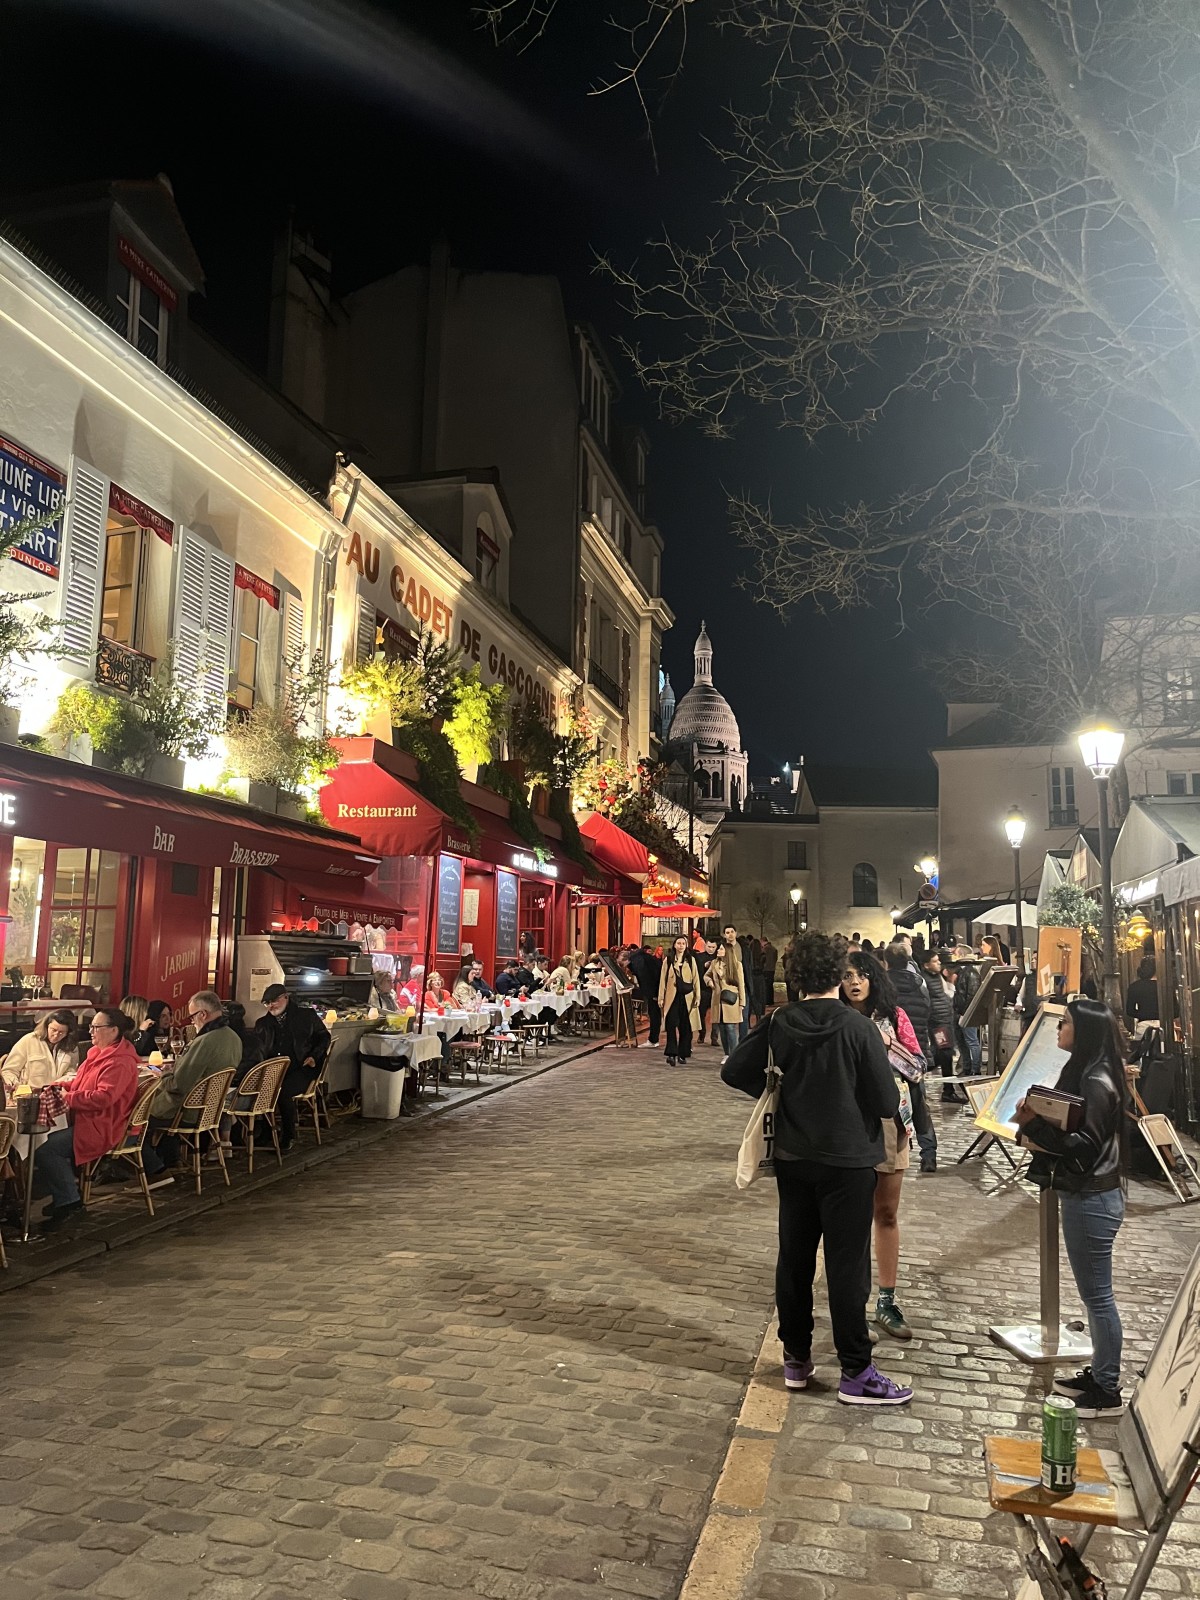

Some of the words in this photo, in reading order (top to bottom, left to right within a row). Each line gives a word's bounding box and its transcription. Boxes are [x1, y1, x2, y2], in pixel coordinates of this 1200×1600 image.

[140, 506, 173, 534] CATHERINE
[10, 548, 52, 572] DUNLOP
[346, 531, 381, 585] AU
[390, 565, 453, 641] CADET
[460, 619, 482, 662] DE
[488, 643, 557, 721] GASCOGNE
[0, 792, 16, 825] E
[337, 803, 418, 818] Restaurant
[152, 825, 176, 853] BAR
[447, 834, 471, 854] Brasserie
[313, 905, 331, 918] FRUITS
[331, 910, 338, 919] DE
[339, 909, 350, 920] MER
[353, 910, 368, 922] VENTE
[373, 913, 396, 926] EMPORTER
[160, 948, 197, 982] JARDIN
[172, 980, 185, 999] ET
